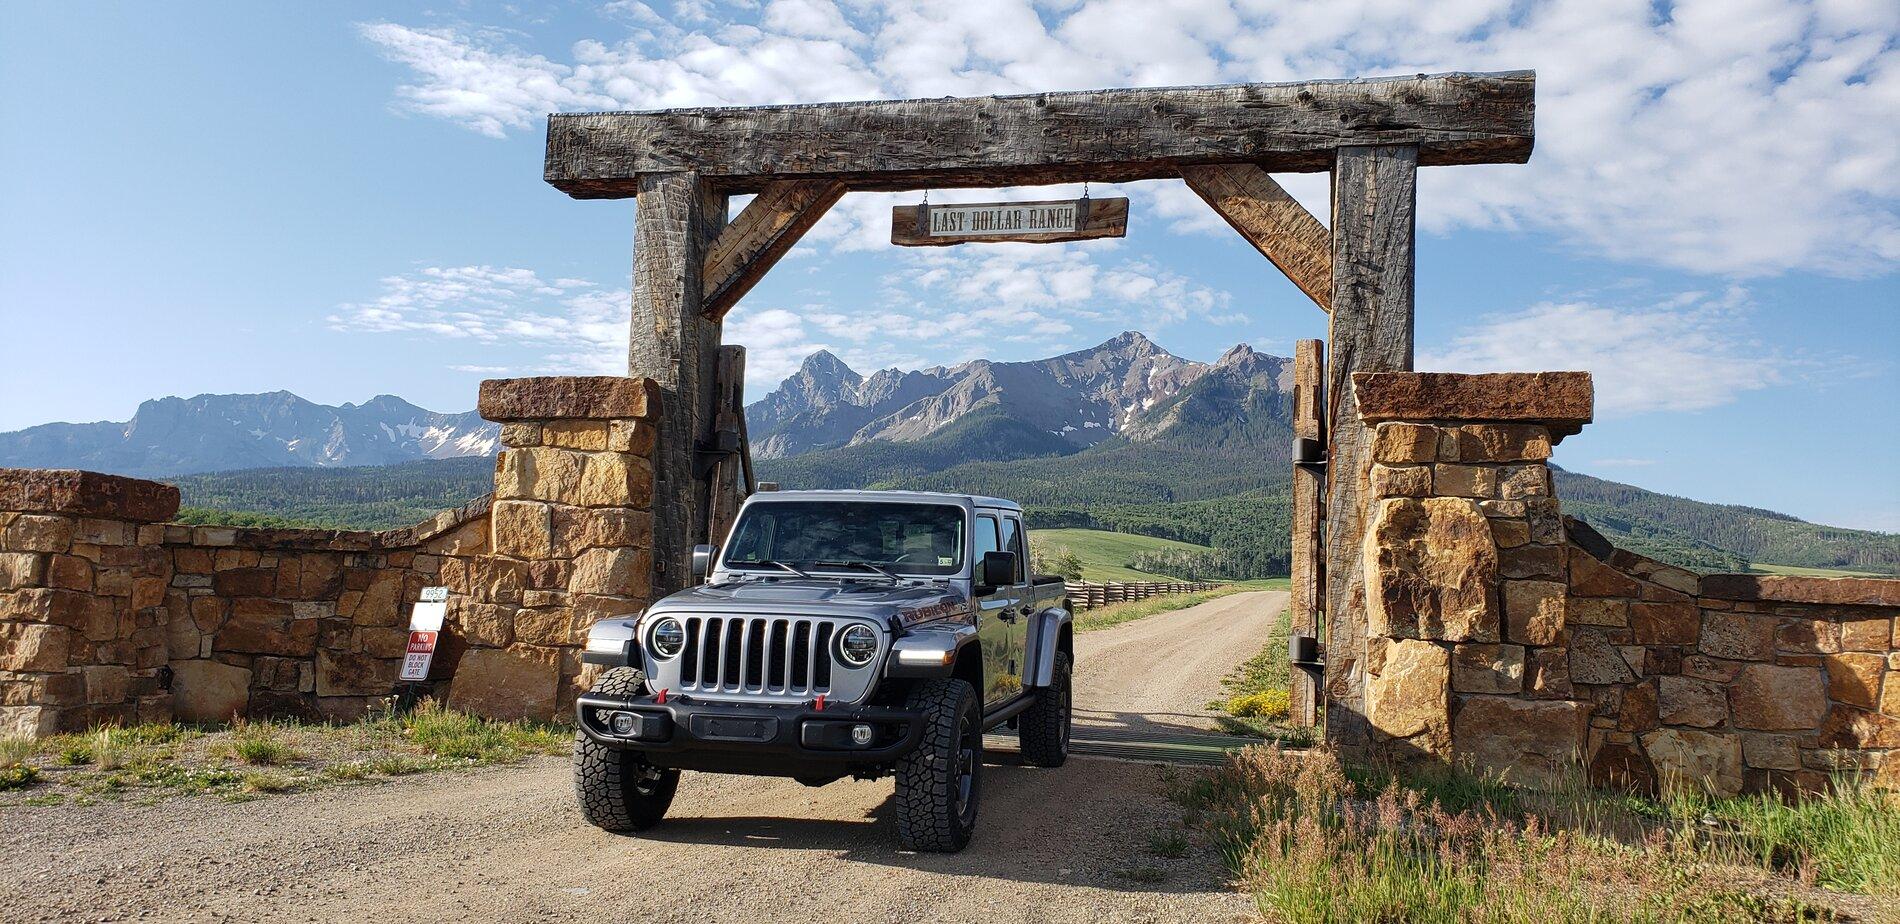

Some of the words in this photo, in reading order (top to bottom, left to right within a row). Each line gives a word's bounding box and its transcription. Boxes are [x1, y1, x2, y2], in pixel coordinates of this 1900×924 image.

[932, 211, 965, 232] LAST
[971, 209, 1021, 231] DOLLAR
[1029, 207, 1073, 229] RANCH
[425, 589, 444, 599] 9952
[902, 602, 958, 622] RUBICON
[417, 633, 429, 642] NO
[409, 643, 433, 651] PARKING
[408, 668, 421, 676] GATE
